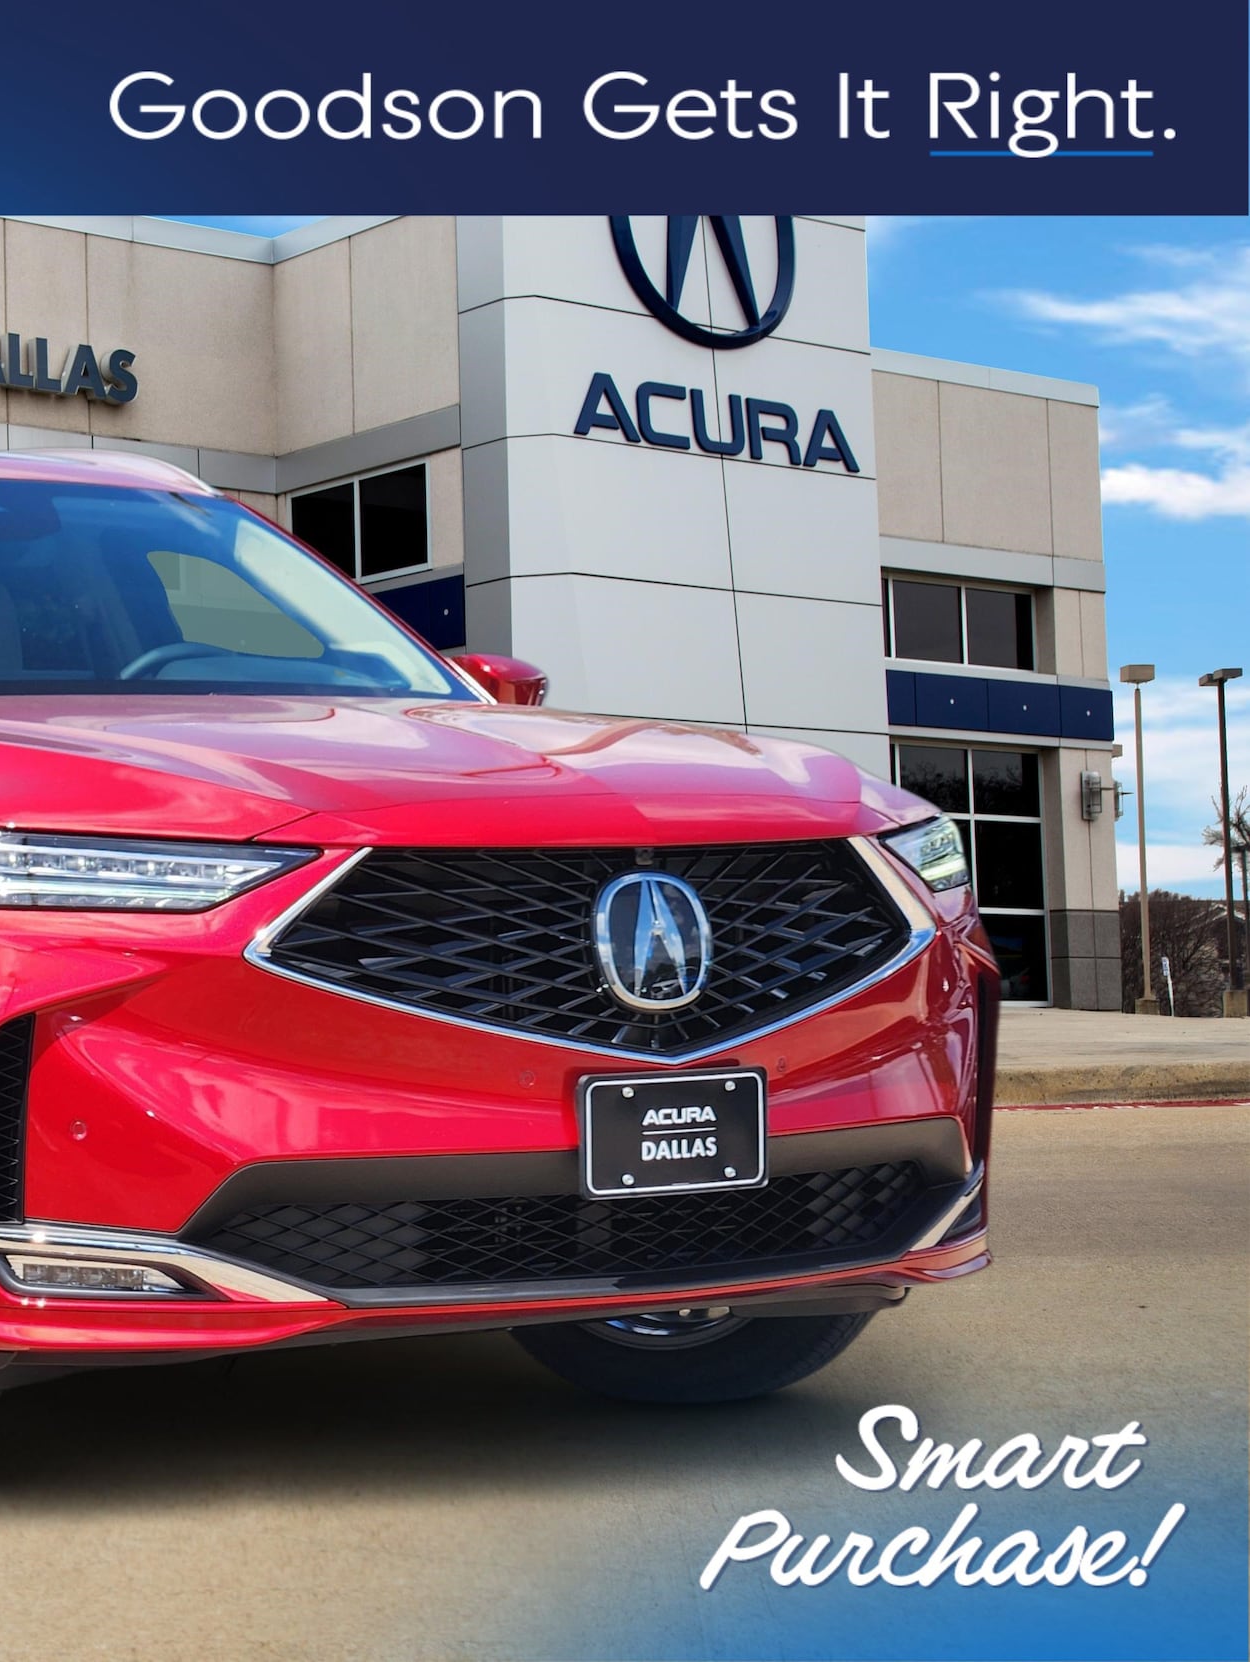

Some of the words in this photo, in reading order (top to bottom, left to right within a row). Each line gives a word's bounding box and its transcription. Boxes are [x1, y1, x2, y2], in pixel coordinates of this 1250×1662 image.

[573, 372, 860, 473] ACURA
[641, 1106, 717, 1126] ACURA
[641, 1137, 718, 1161] DALLAS
